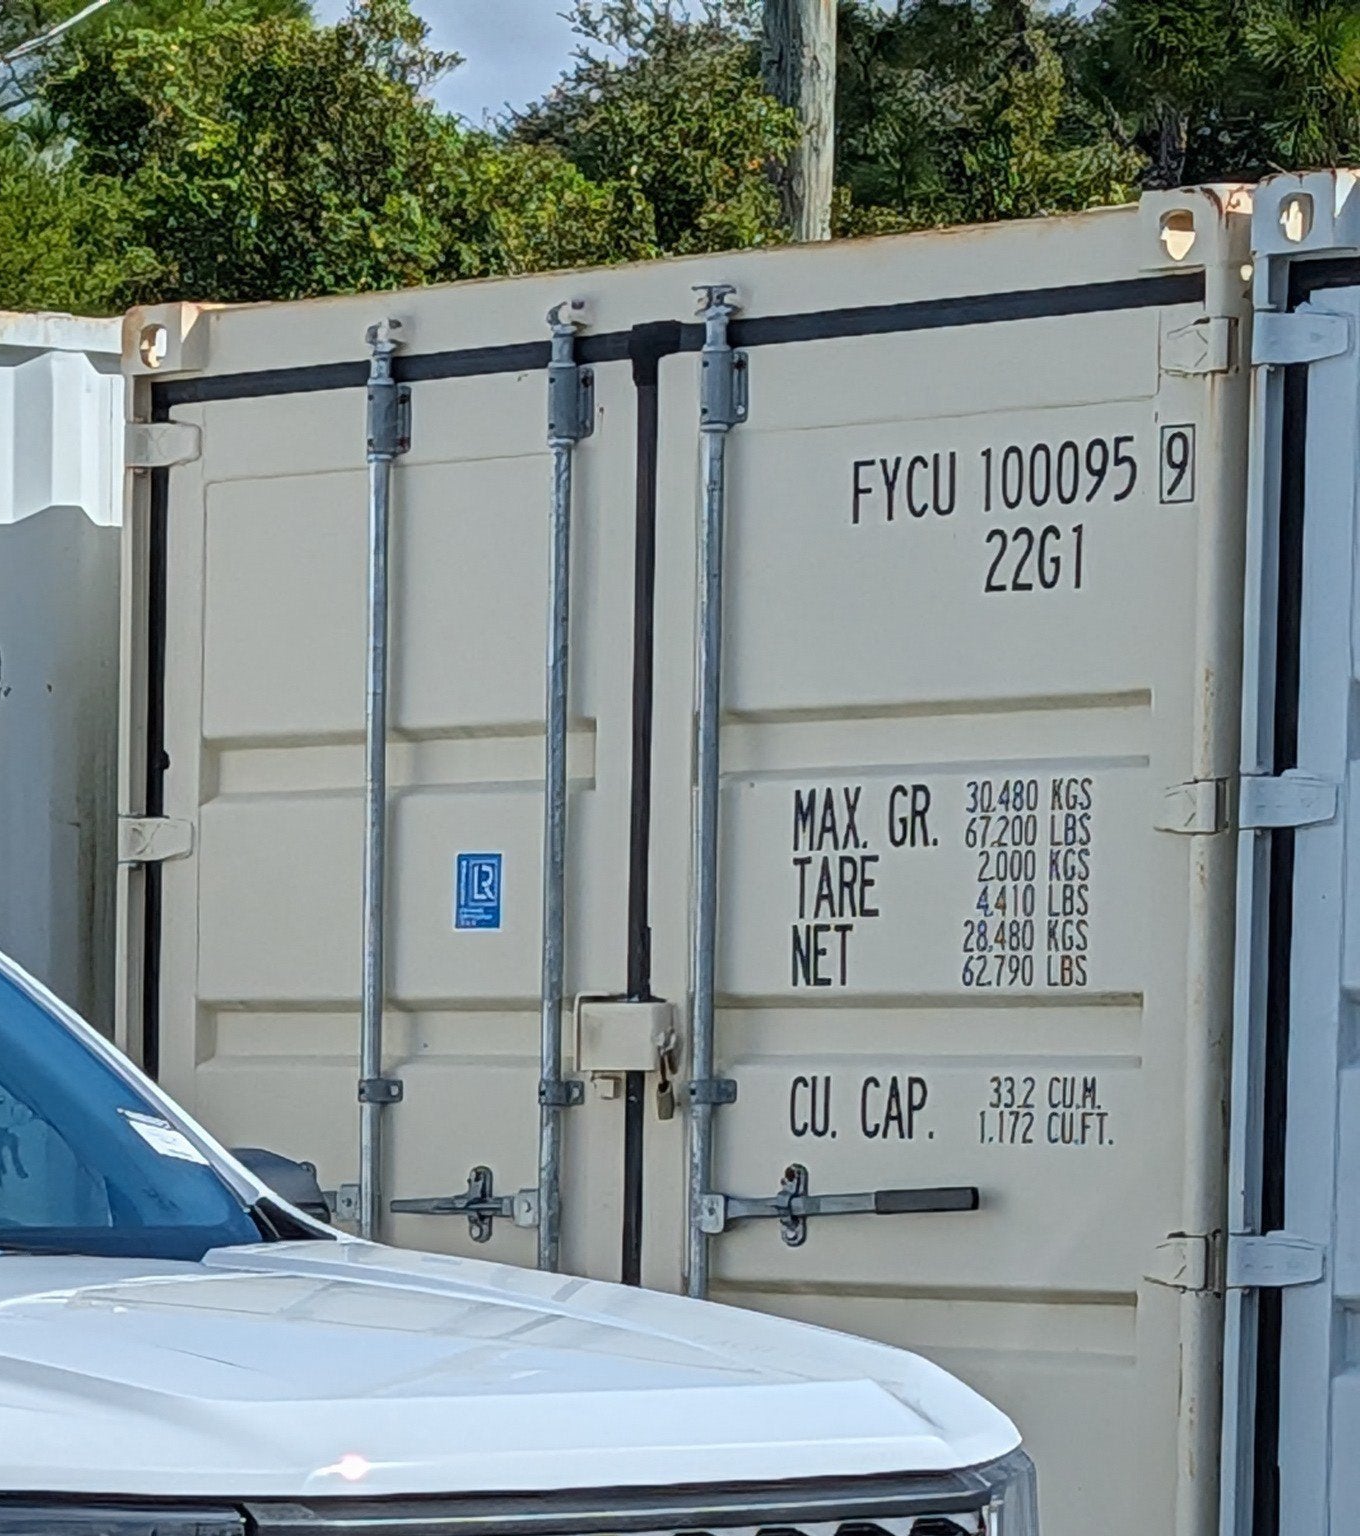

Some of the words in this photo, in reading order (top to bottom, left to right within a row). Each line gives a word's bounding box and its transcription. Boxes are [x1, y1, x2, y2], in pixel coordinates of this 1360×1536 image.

[851, 450, 957, 525] FYCU
[980, 435, 1138, 513] 1000095
[1166, 431, 1189, 496] 9
[983, 523, 1084, 594] 22G1
[792, 786, 868, 852] MAX.
[888, 783, 939, 848] GR.
[1050, 777, 1093, 811] KGS
[1049, 812, 1092, 846] LBS
[473, 864, 495, 900] LR
[792, 854, 880, 919] TARE
[1048, 848, 1091, 882] KGS
[1047, 883, 1089, 917] LBS
[791, 923, 854, 987] NET
[1047, 918, 1089, 953] KGS
[1046, 954, 1088, 987] LBS
[789, 1075, 837, 1140] CU.
[860, 1075, 935, 1140] CAP.
